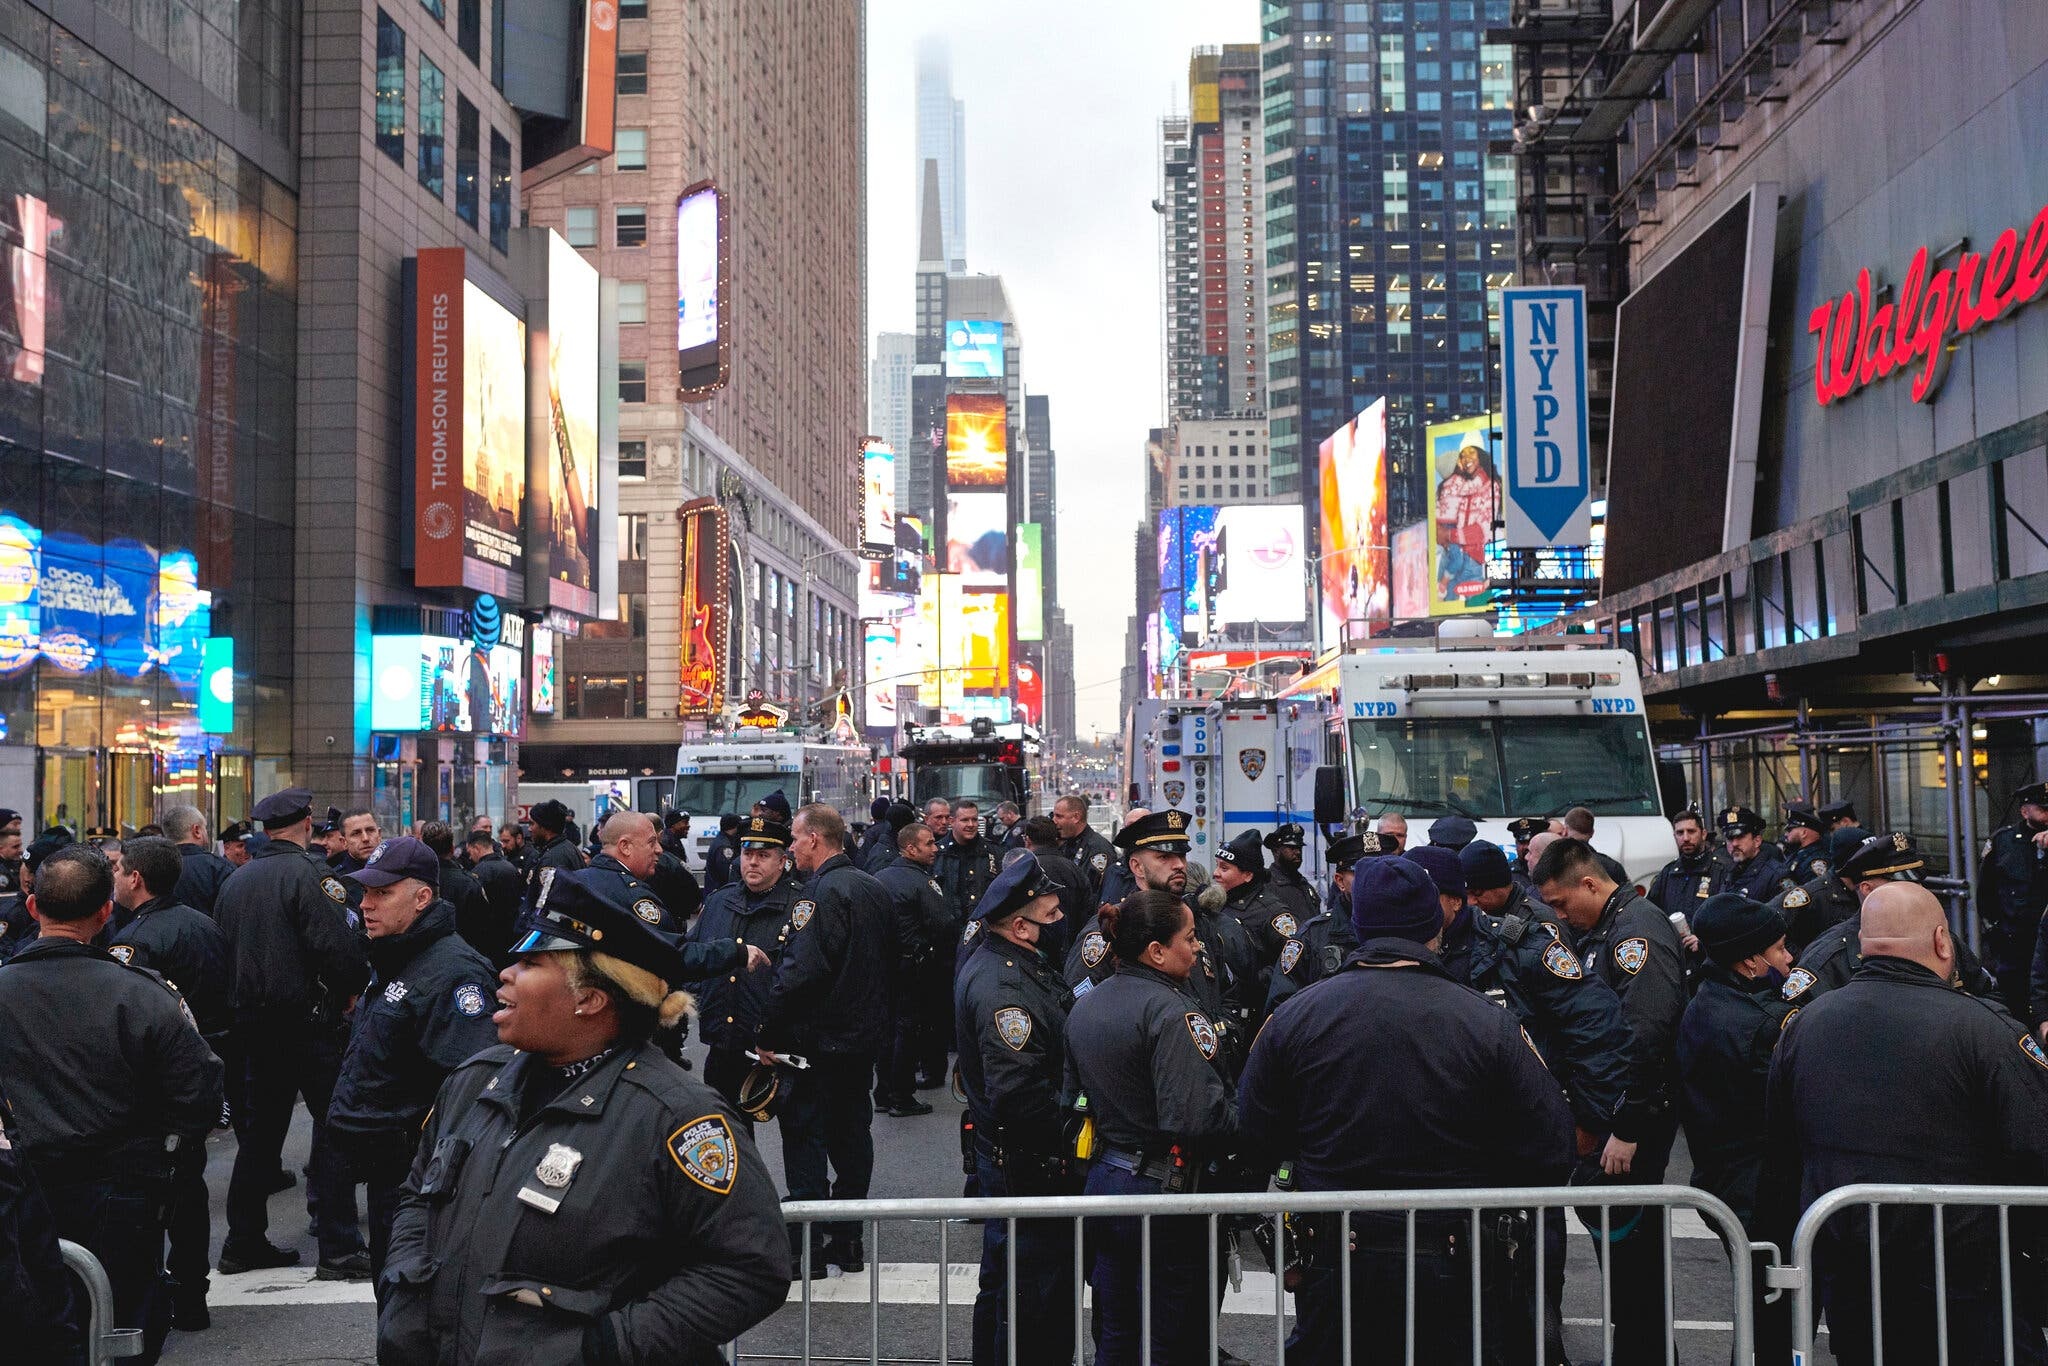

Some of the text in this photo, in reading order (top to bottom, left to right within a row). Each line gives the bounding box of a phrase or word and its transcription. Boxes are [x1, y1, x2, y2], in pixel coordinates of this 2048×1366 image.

[432, 293, 449, 491] THOMSON REUTERS
[1528, 302, 1562, 484] NYPD
[1456, 583, 1485, 594] OLD NAVY
[500, 612, 525, 648] AT&T
[1353, 701, 1398, 717] NYPD
[1592, 697, 1637, 713] NYPD
[757, 713, 778, 728] Rock
[1195, 717, 1207, 754] SOD
[780, 764, 799, 772] NYPD
[456, 985, 481, 999] POLICE
[683, 1121, 713, 1140] POLICE
[678, 1127, 725, 1156] DEPARTMENT
[725, 1137, 735, 1180] NEW YORK
[685, 1162, 716, 1185] CITY OF
